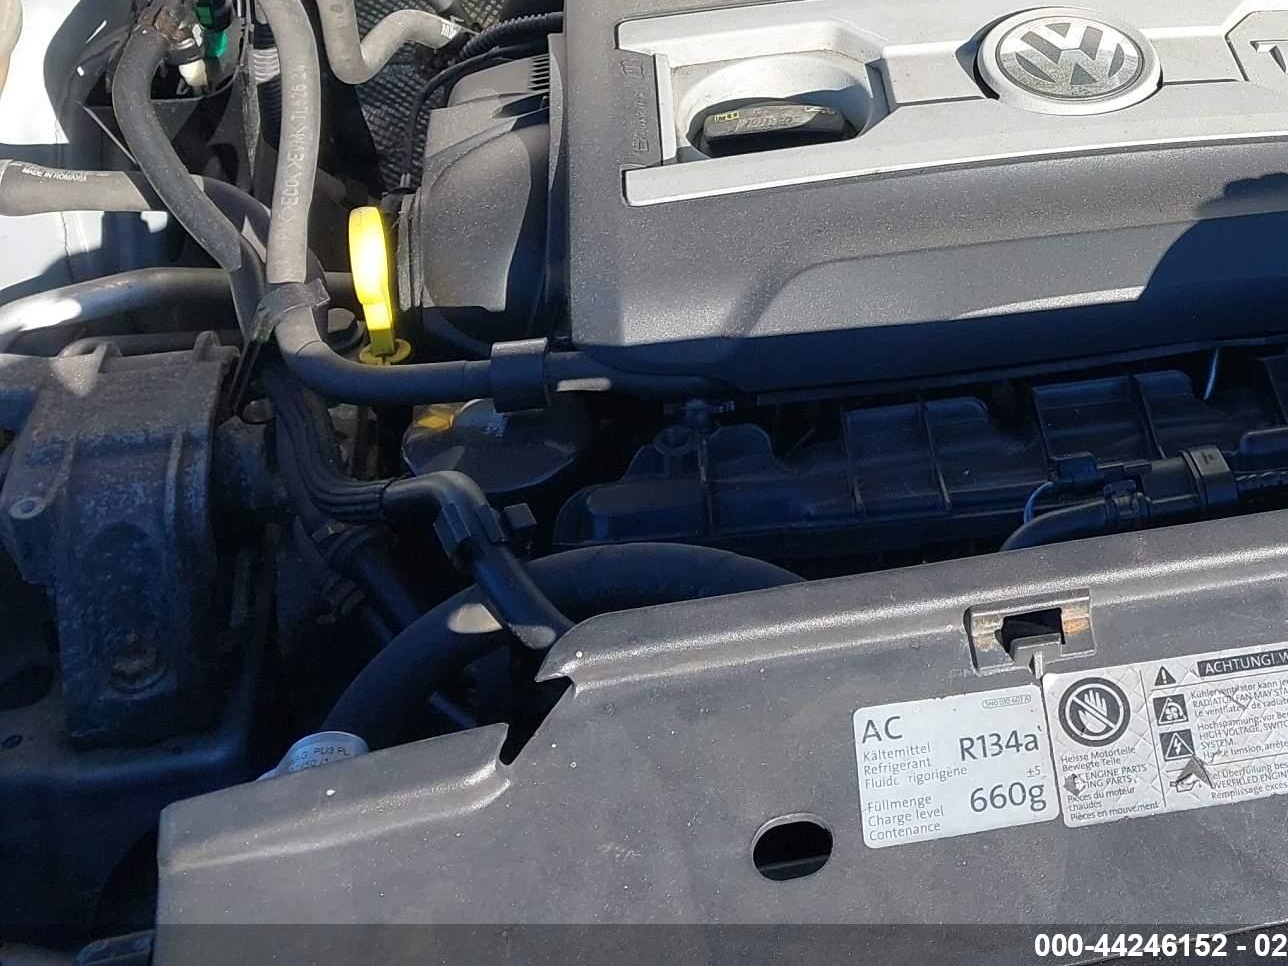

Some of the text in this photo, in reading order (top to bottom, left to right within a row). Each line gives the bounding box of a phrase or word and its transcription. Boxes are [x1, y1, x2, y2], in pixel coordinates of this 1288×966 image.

[1205, 653, 1275, 674] ACHTUNG!
[1257, 680, 1278, 689] kann
[1255, 689, 1272, 699] MAY
[1251, 701, 1261, 709] de
[862, 716, 903, 744] AC
[863, 730, 1039, 763] Kältemittel R134a
[864, 757, 932, 776] Refrigerant
[1062, 757, 1121, 772] Bewegte Teile
[1086, 769, 1118, 780] ENGINE
[1122, 764, 1147, 774] PARTS
[906, 766, 968, 787] rigorigène
[867, 782, 1047, 814] Füllmenge 660g
[1094, 787, 1135, 799] du moteur
[1212, 785, 1263, 799] Remplissage
[1069, 801, 1102, 812] chaudes
[1109, 801, 1159, 815] mouvement
[868, 805, 944, 827] Charge level
[869, 821, 941, 842] Contenance
